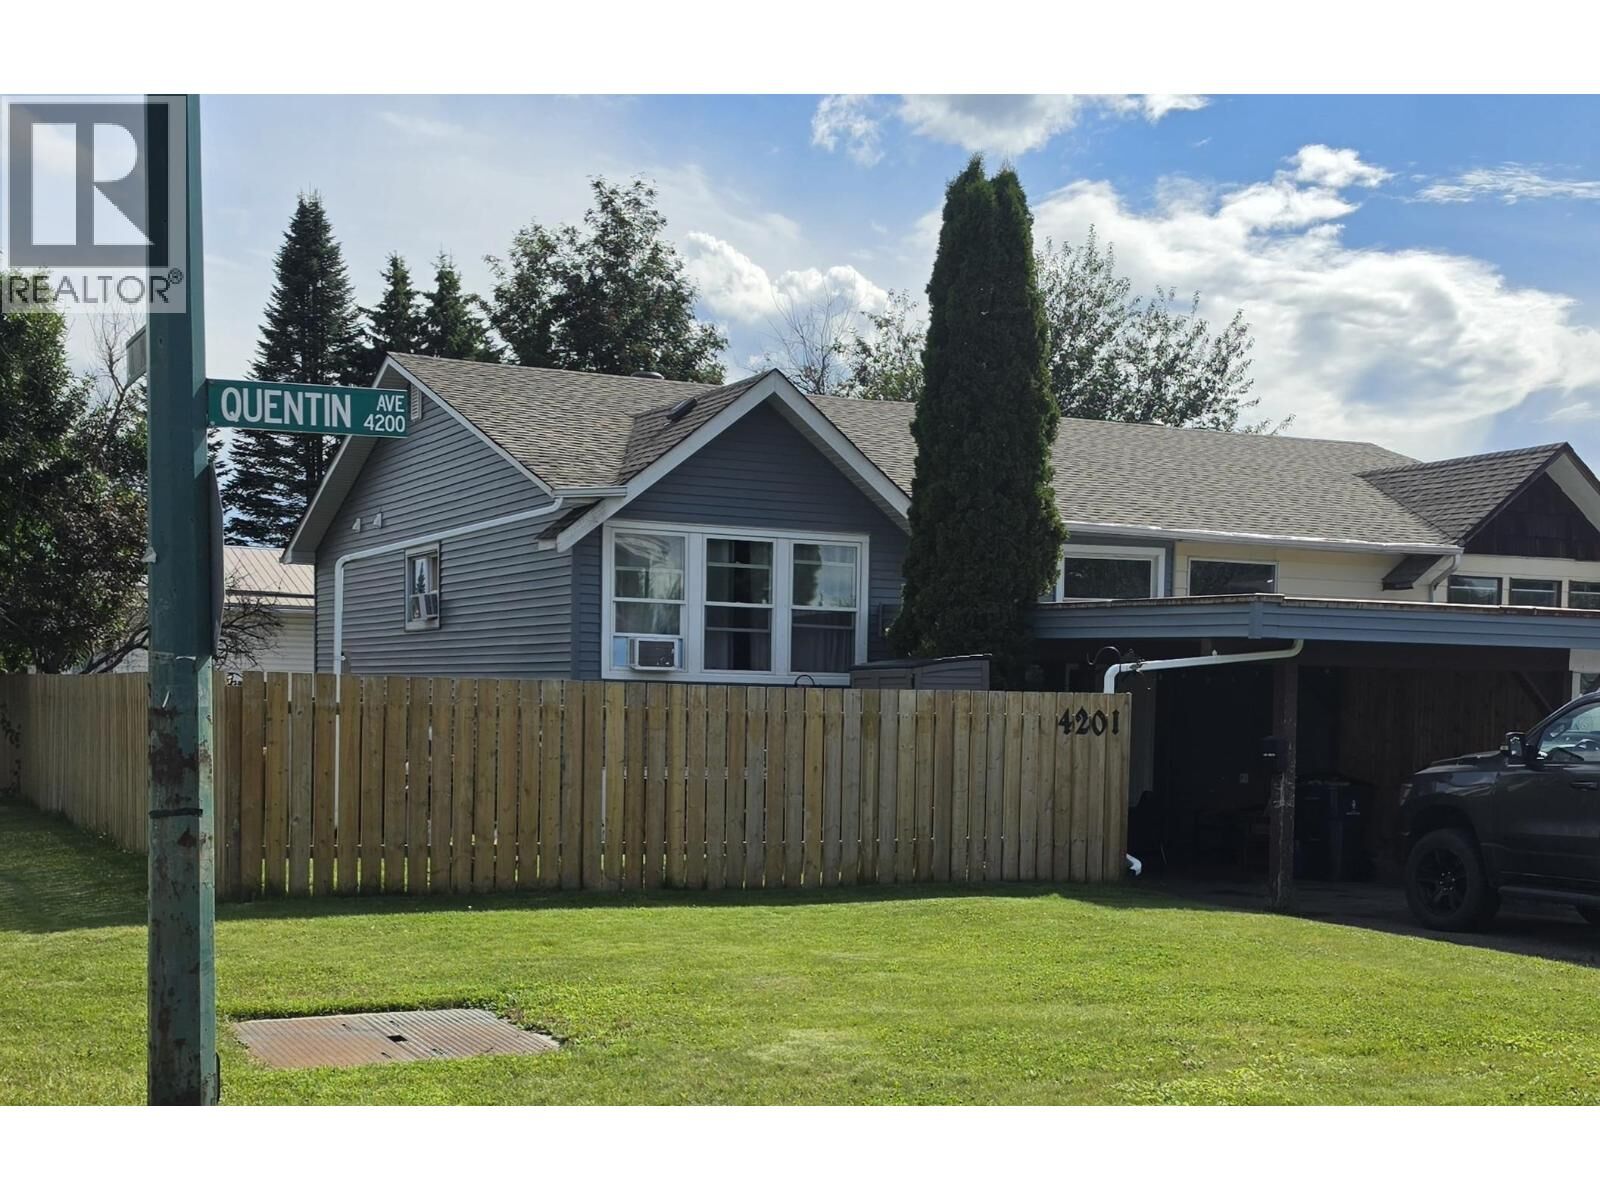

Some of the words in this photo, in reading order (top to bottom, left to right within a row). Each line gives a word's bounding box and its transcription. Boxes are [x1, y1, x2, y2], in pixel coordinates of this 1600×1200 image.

[220, 386, 352, 428] QUENTIN
[376, 394, 405, 413] AVE
[363, 414, 406, 433] 4200
[1058, 705, 1120, 736] 4201
